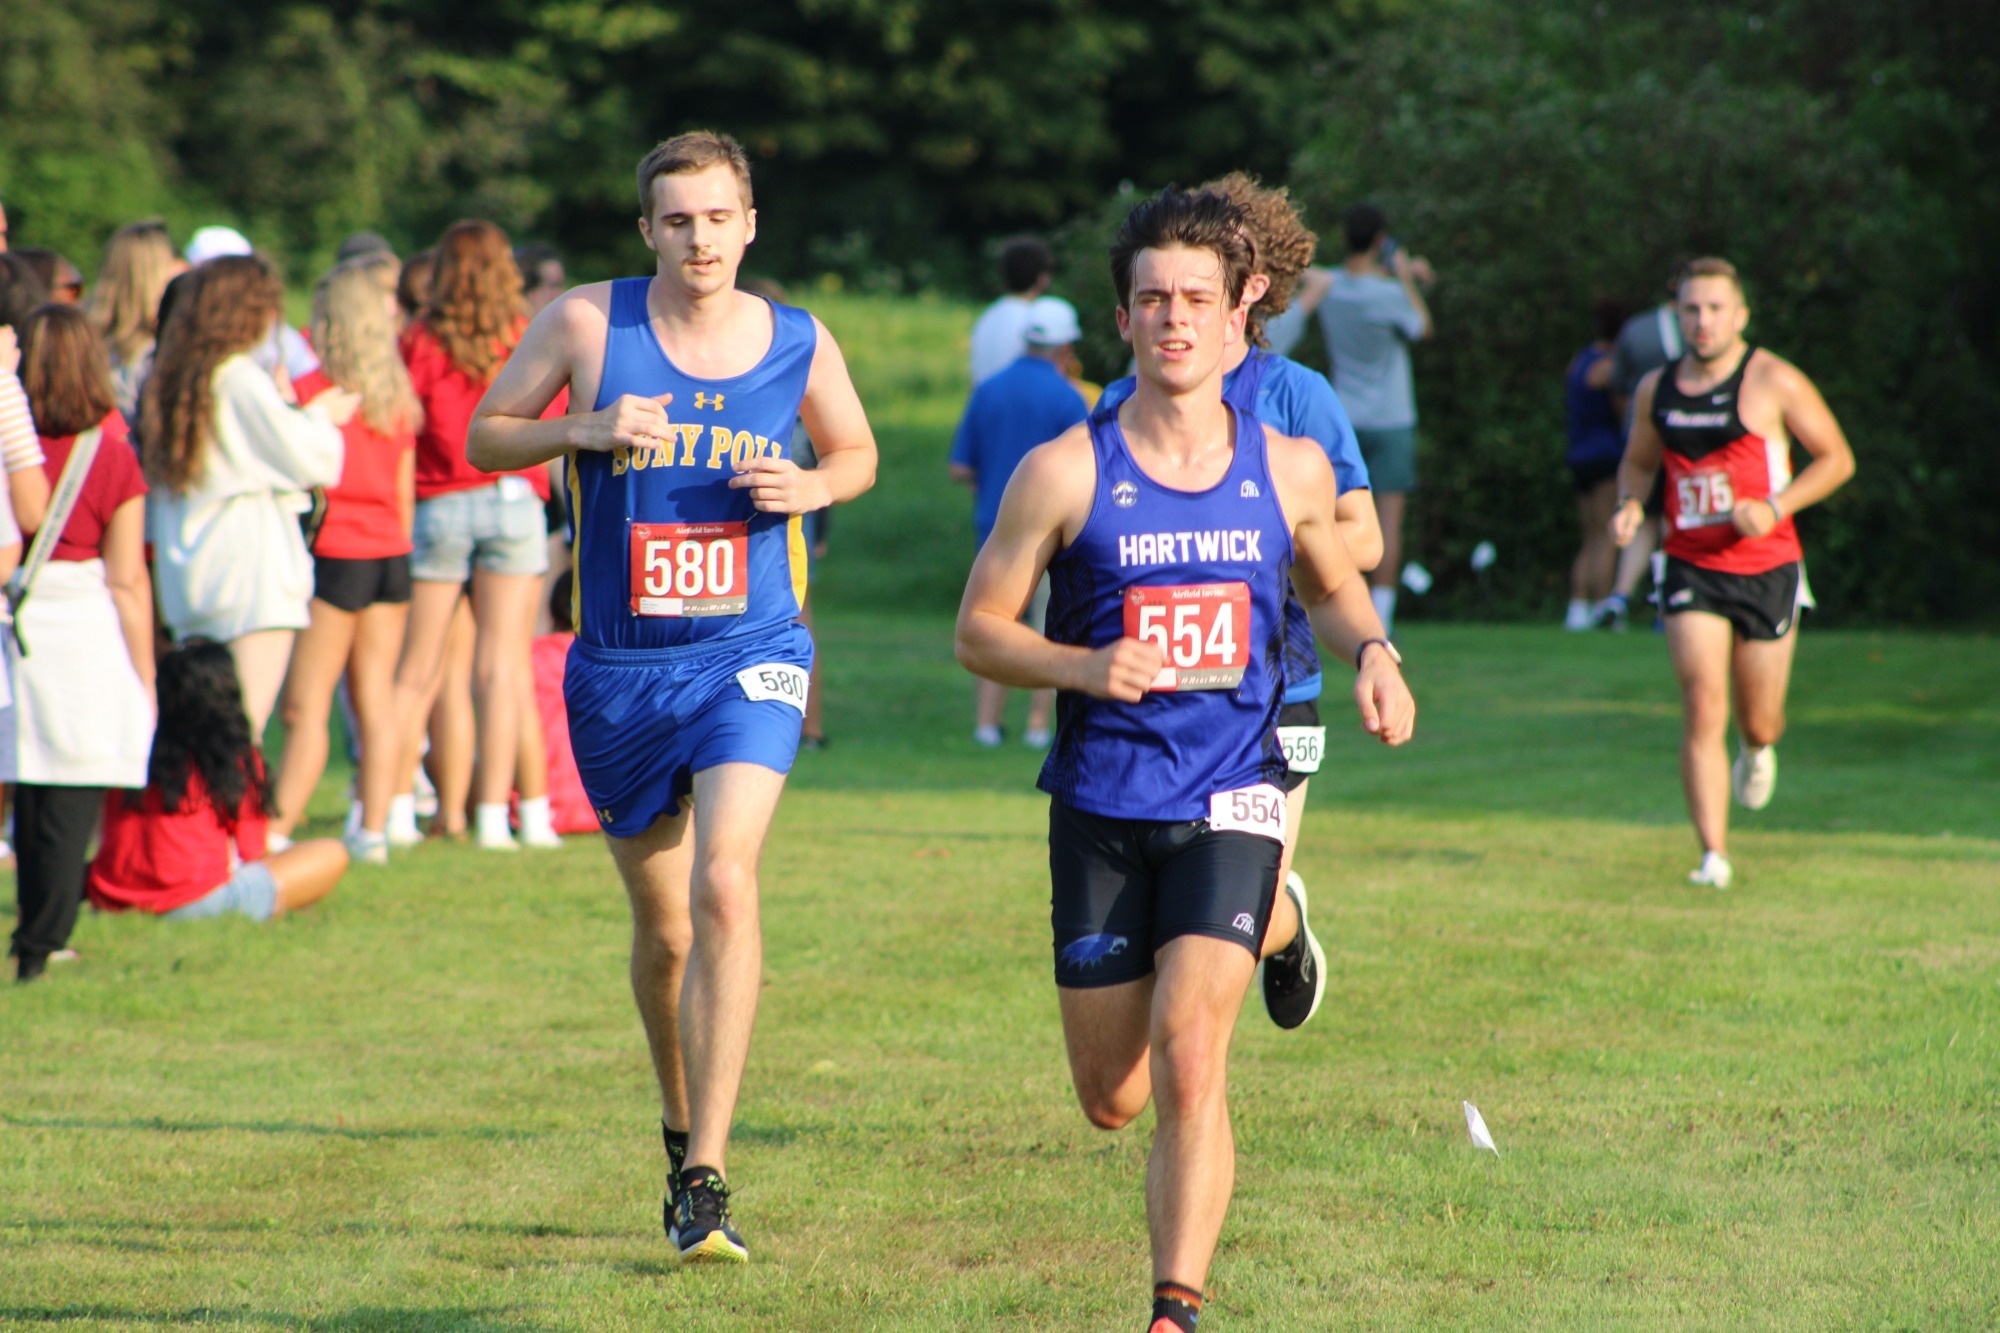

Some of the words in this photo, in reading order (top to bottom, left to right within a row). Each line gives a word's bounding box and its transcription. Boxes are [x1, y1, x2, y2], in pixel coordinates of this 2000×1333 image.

[1677, 472, 1734, 515] 575
[644, 538, 734, 596] 580
[1119, 530, 1262, 567] HARTWICK
[1172, 589, 1201, 600] Airfield
[1201, 588, 1224, 598] Invite
[1139, 602, 1237, 667] 554
[759, 671, 803, 701] 580
[1282, 736, 1318, 762] 556
[1231, 790, 1281, 828] 554
